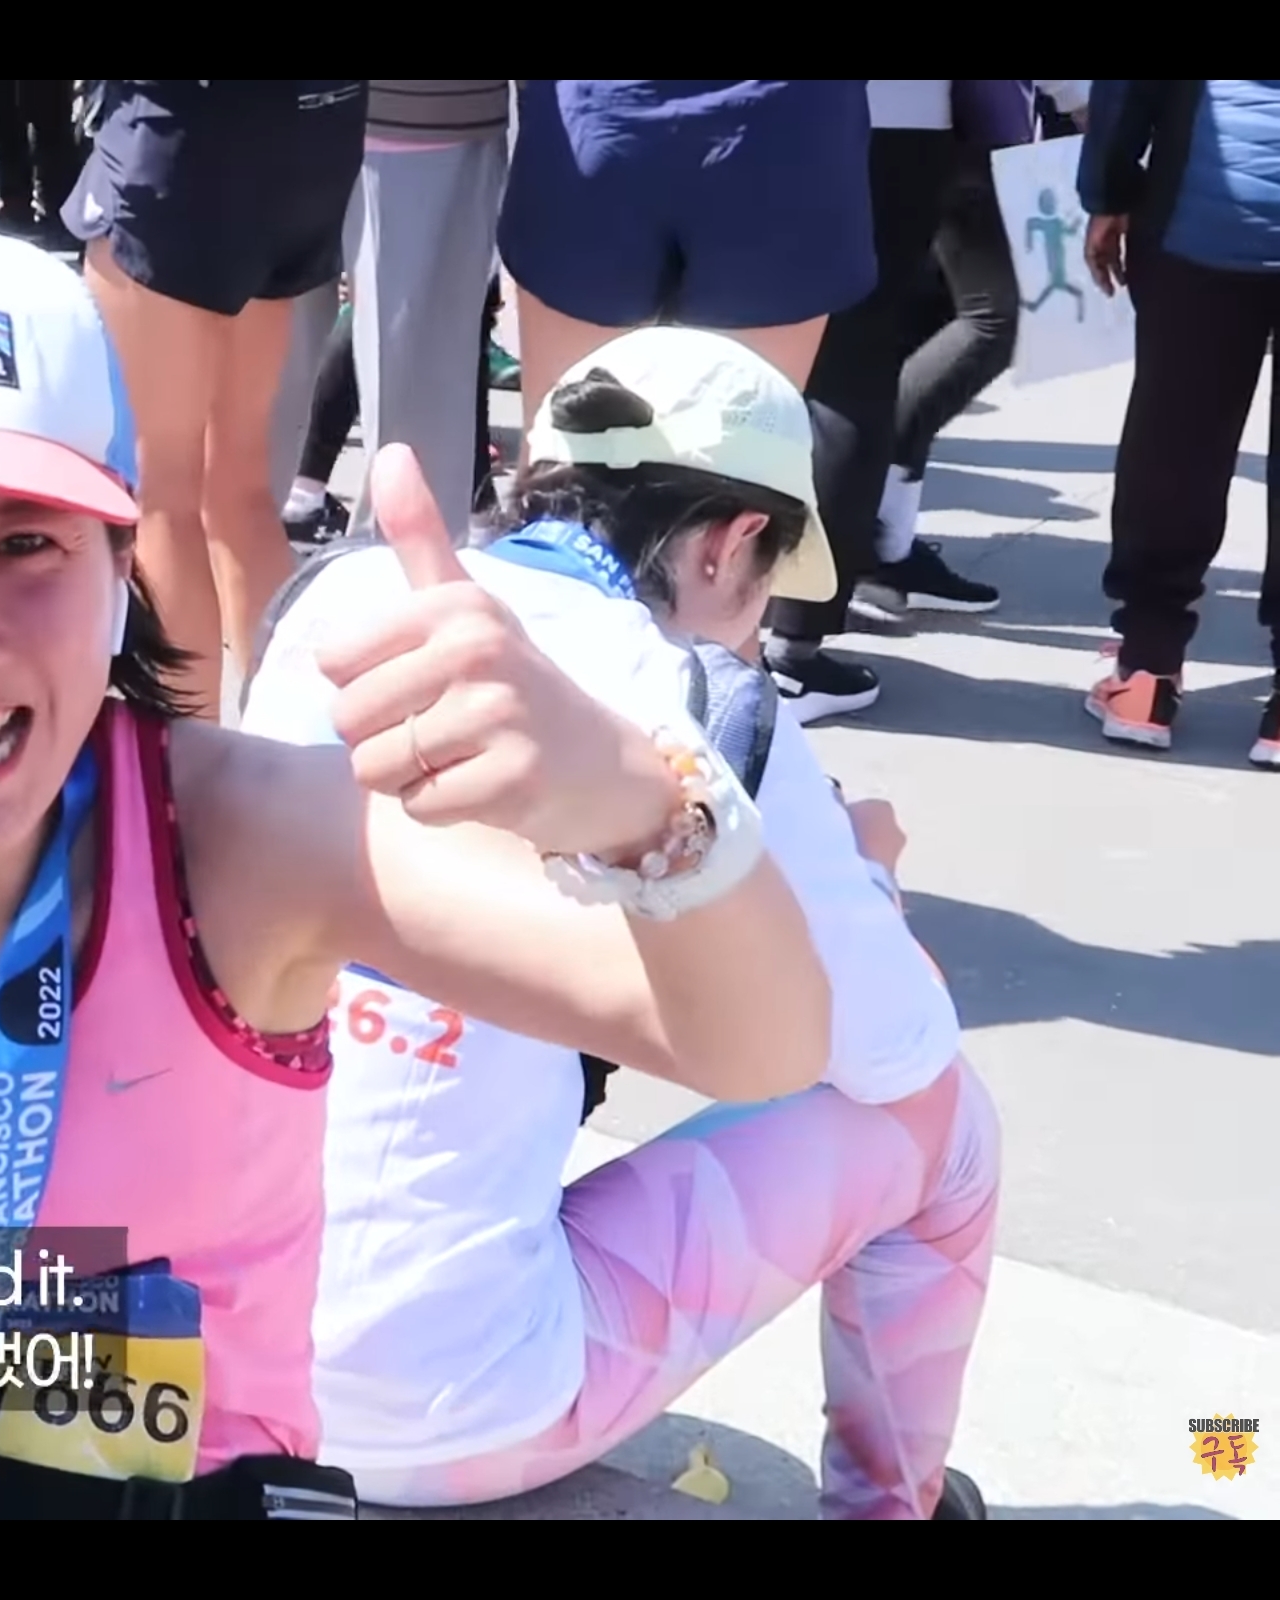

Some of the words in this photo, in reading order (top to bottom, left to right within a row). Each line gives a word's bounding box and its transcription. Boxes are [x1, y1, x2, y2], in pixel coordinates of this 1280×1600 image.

[574, 534, 620, 575] SAN
[37, 966, 62, 1039] 2022
[328, 984, 464, 1069] 6.2
